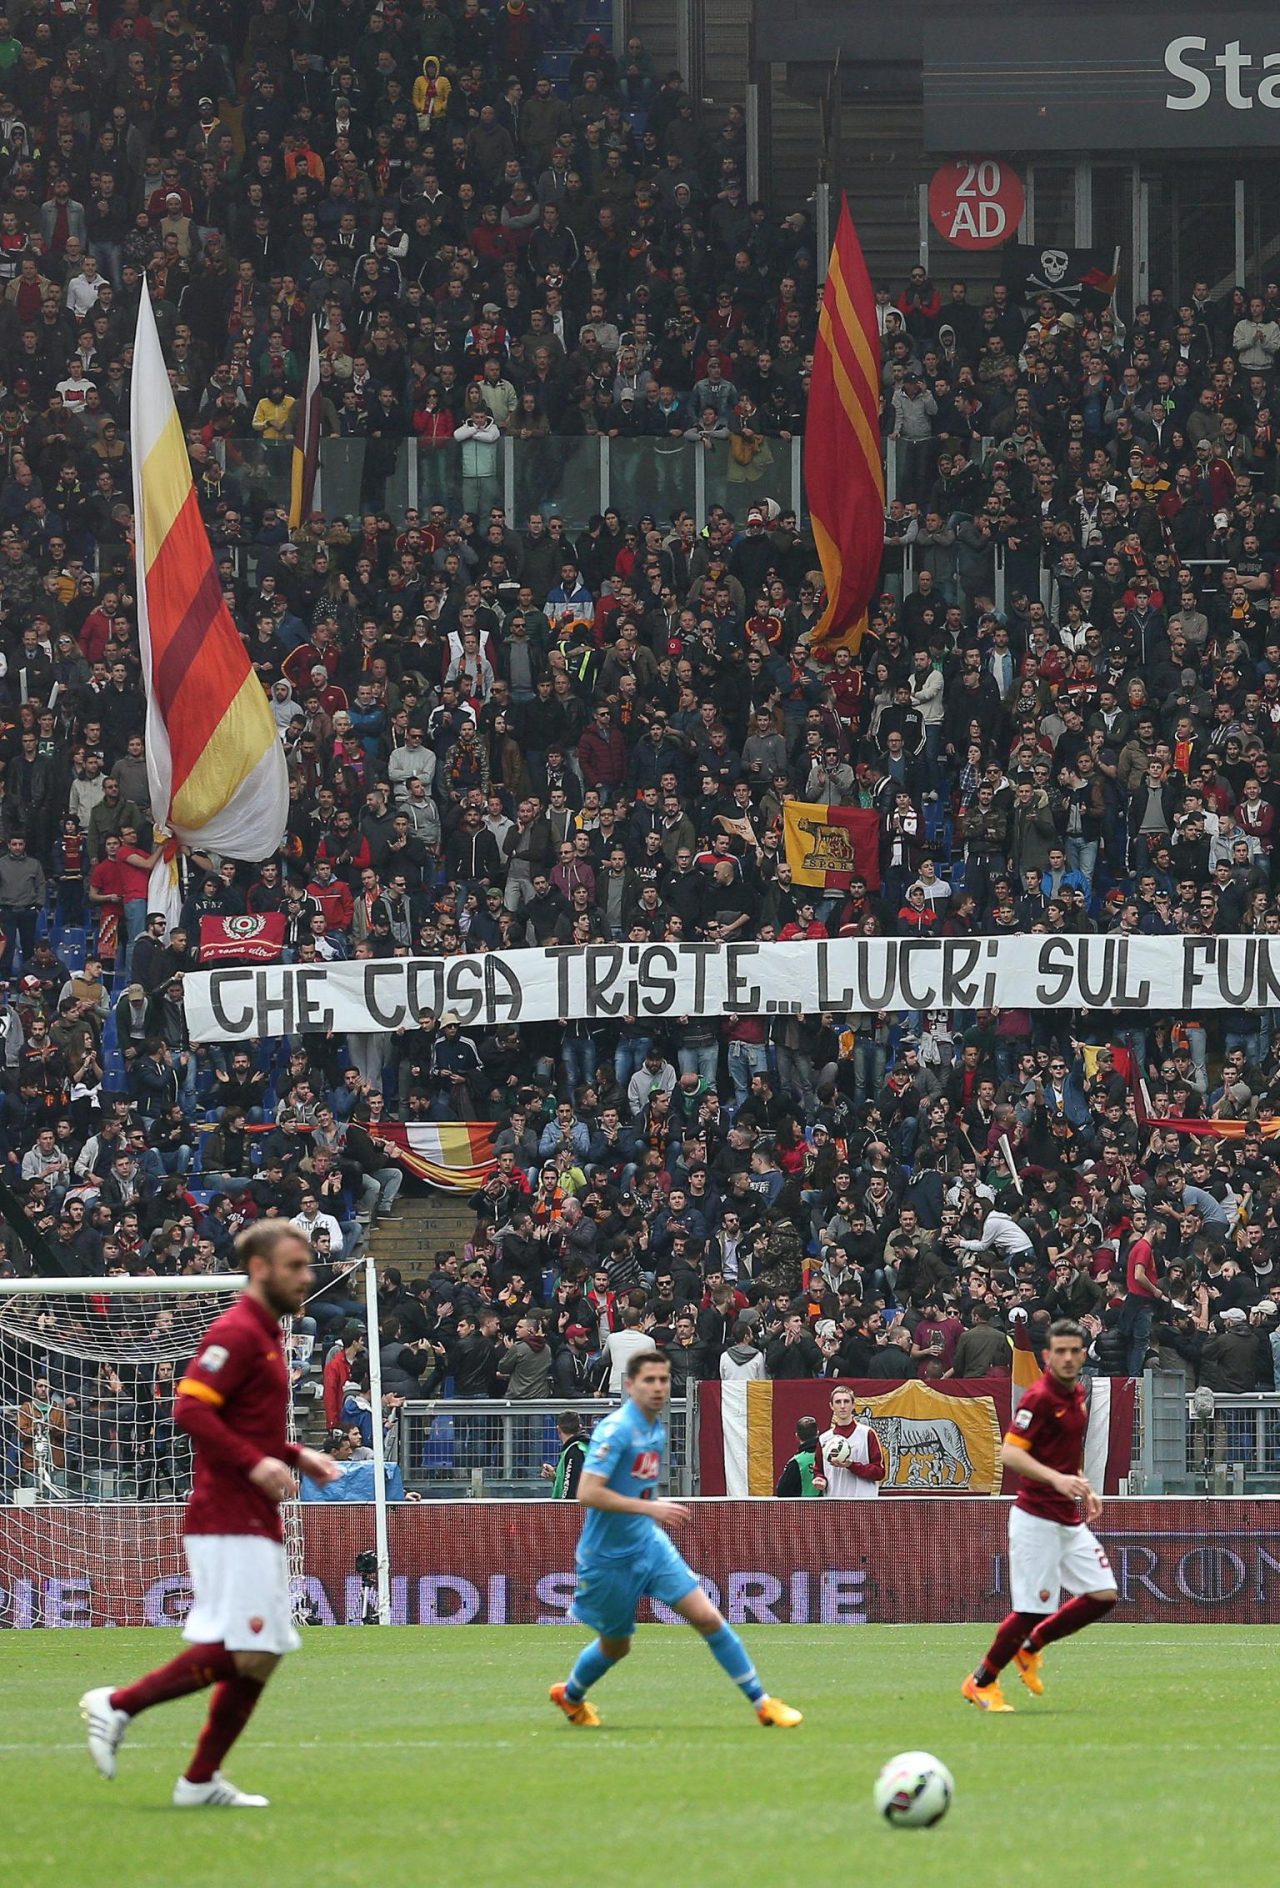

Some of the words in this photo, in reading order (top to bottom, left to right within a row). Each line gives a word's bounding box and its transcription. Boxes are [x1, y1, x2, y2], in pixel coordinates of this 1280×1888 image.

[955, 160, 1001, 197] 20
[949, 201, 1006, 238] AD
[209, 969, 334, 1037] CHE
[362, 953, 522, 1031] COSA
[1036, 937, 1150, 1008] SUL
[144, 1574, 505, 1628] GANDI
[536, 1571, 866, 1625] SORIE
